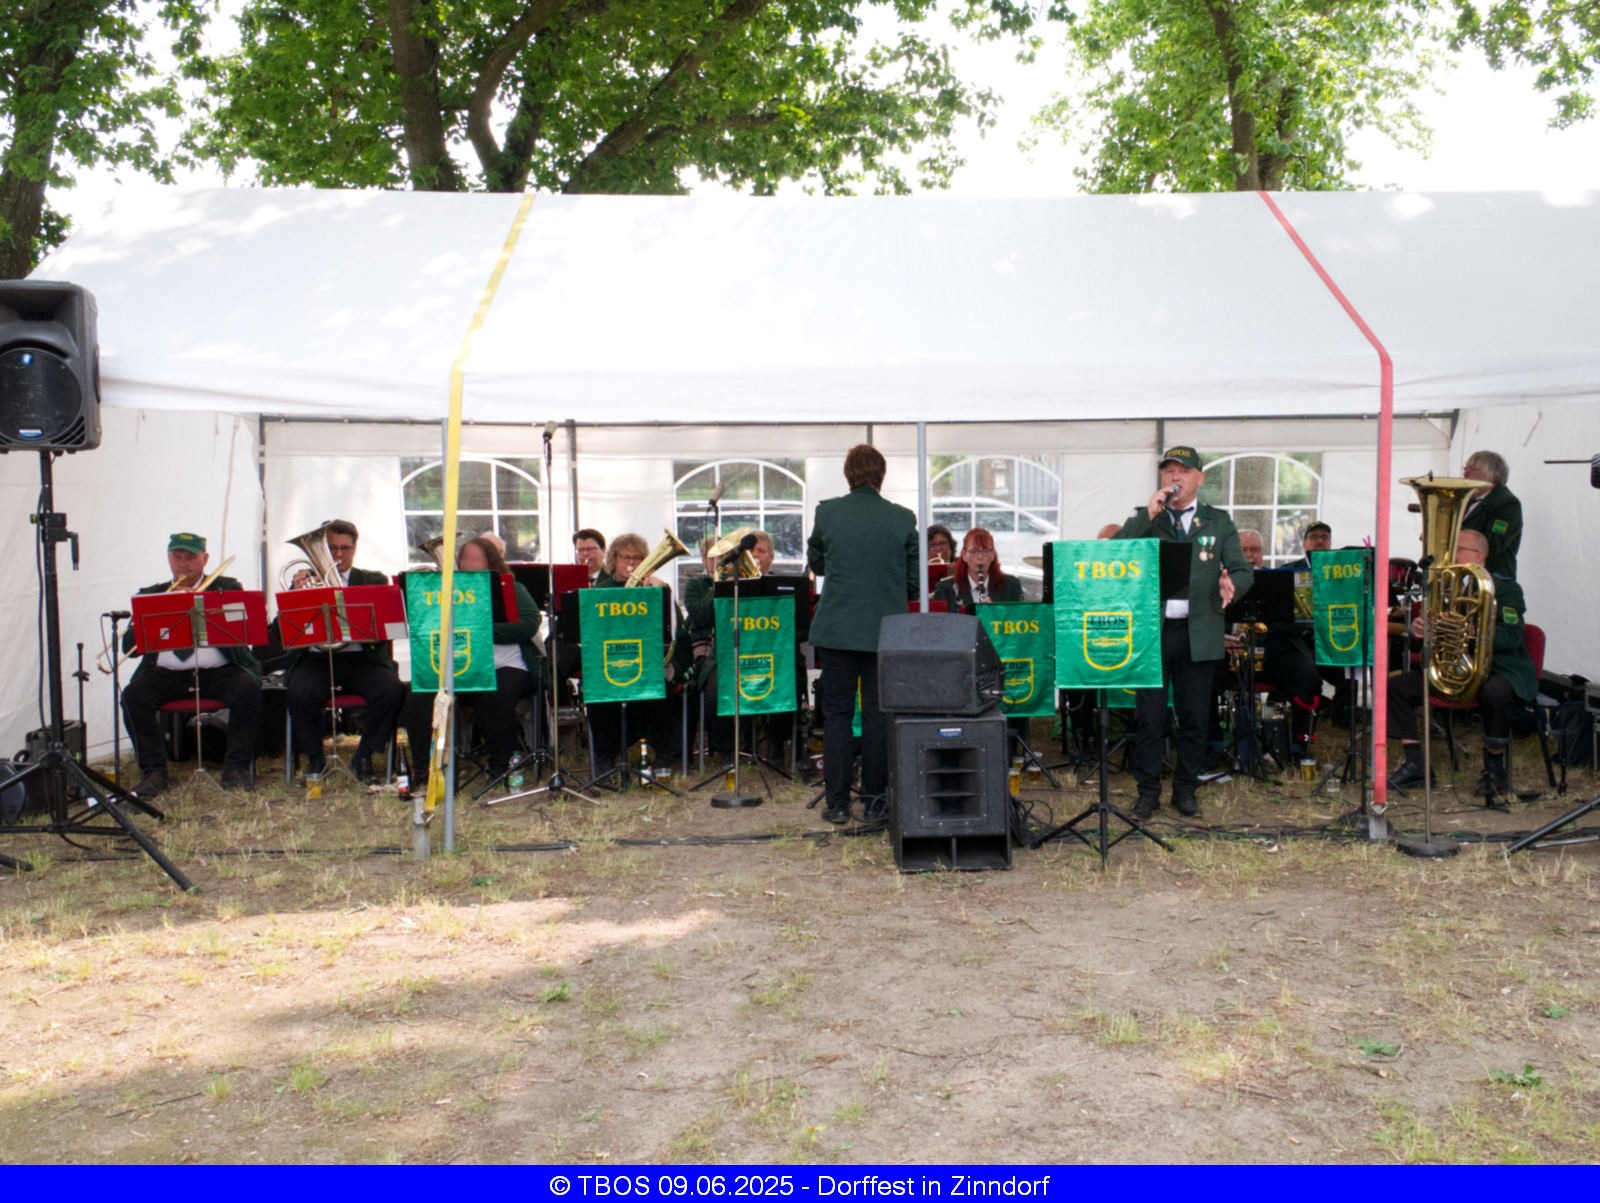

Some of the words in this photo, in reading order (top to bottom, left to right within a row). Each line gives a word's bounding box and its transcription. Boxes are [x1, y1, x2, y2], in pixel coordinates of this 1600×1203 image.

[1074, 560, 1140, 579] TBOS
[1322, 564, 1361, 579] TBOS
[595, 601, 648, 617] TBOS
[990, 620, 1040, 634] TBOS
[1090, 615, 1126, 626] TBOS
[607, 643, 638, 652] TBOS
